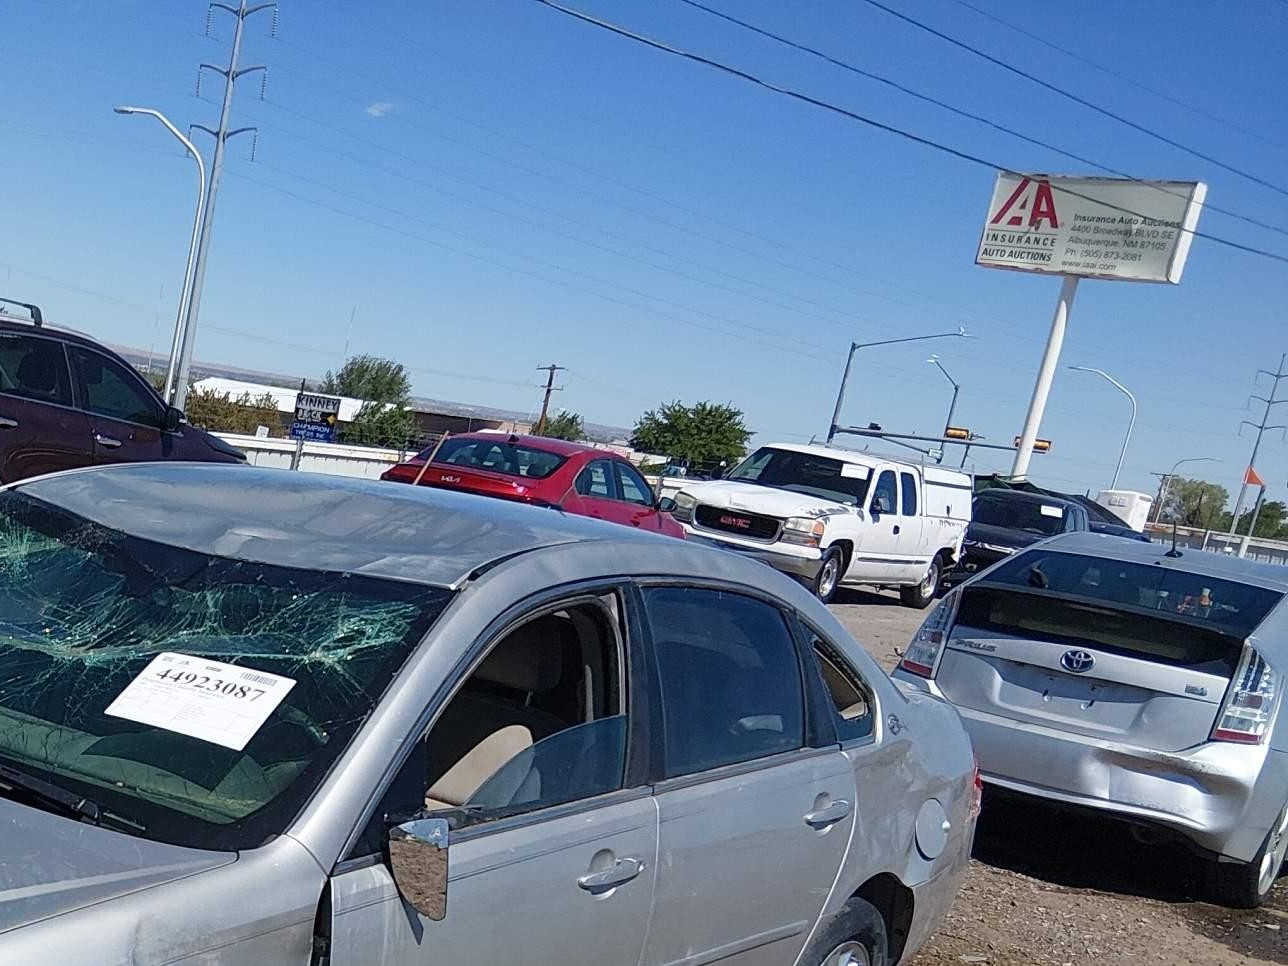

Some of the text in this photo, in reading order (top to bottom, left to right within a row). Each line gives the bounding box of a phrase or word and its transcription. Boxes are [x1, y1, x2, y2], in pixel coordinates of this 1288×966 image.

[1073, 213, 1116, 224] Insurance
[1117, 216, 1139, 225] Auto
[1071, 225, 1175, 239] 4400 Broadway BLVD SE
[986, 233, 1057, 247] INSURANCE
[1122, 240, 1139, 249] NM
[981, 247, 1053, 262] AUTO AUCTIONS
[297, 395, 338, 410] KINNEY
[440, 475, 461, 483] KIA
[720, 516, 751, 529] GMC
[955, 639, 997, 652] PRIUS
[155, 668, 267, 701] 44923087
